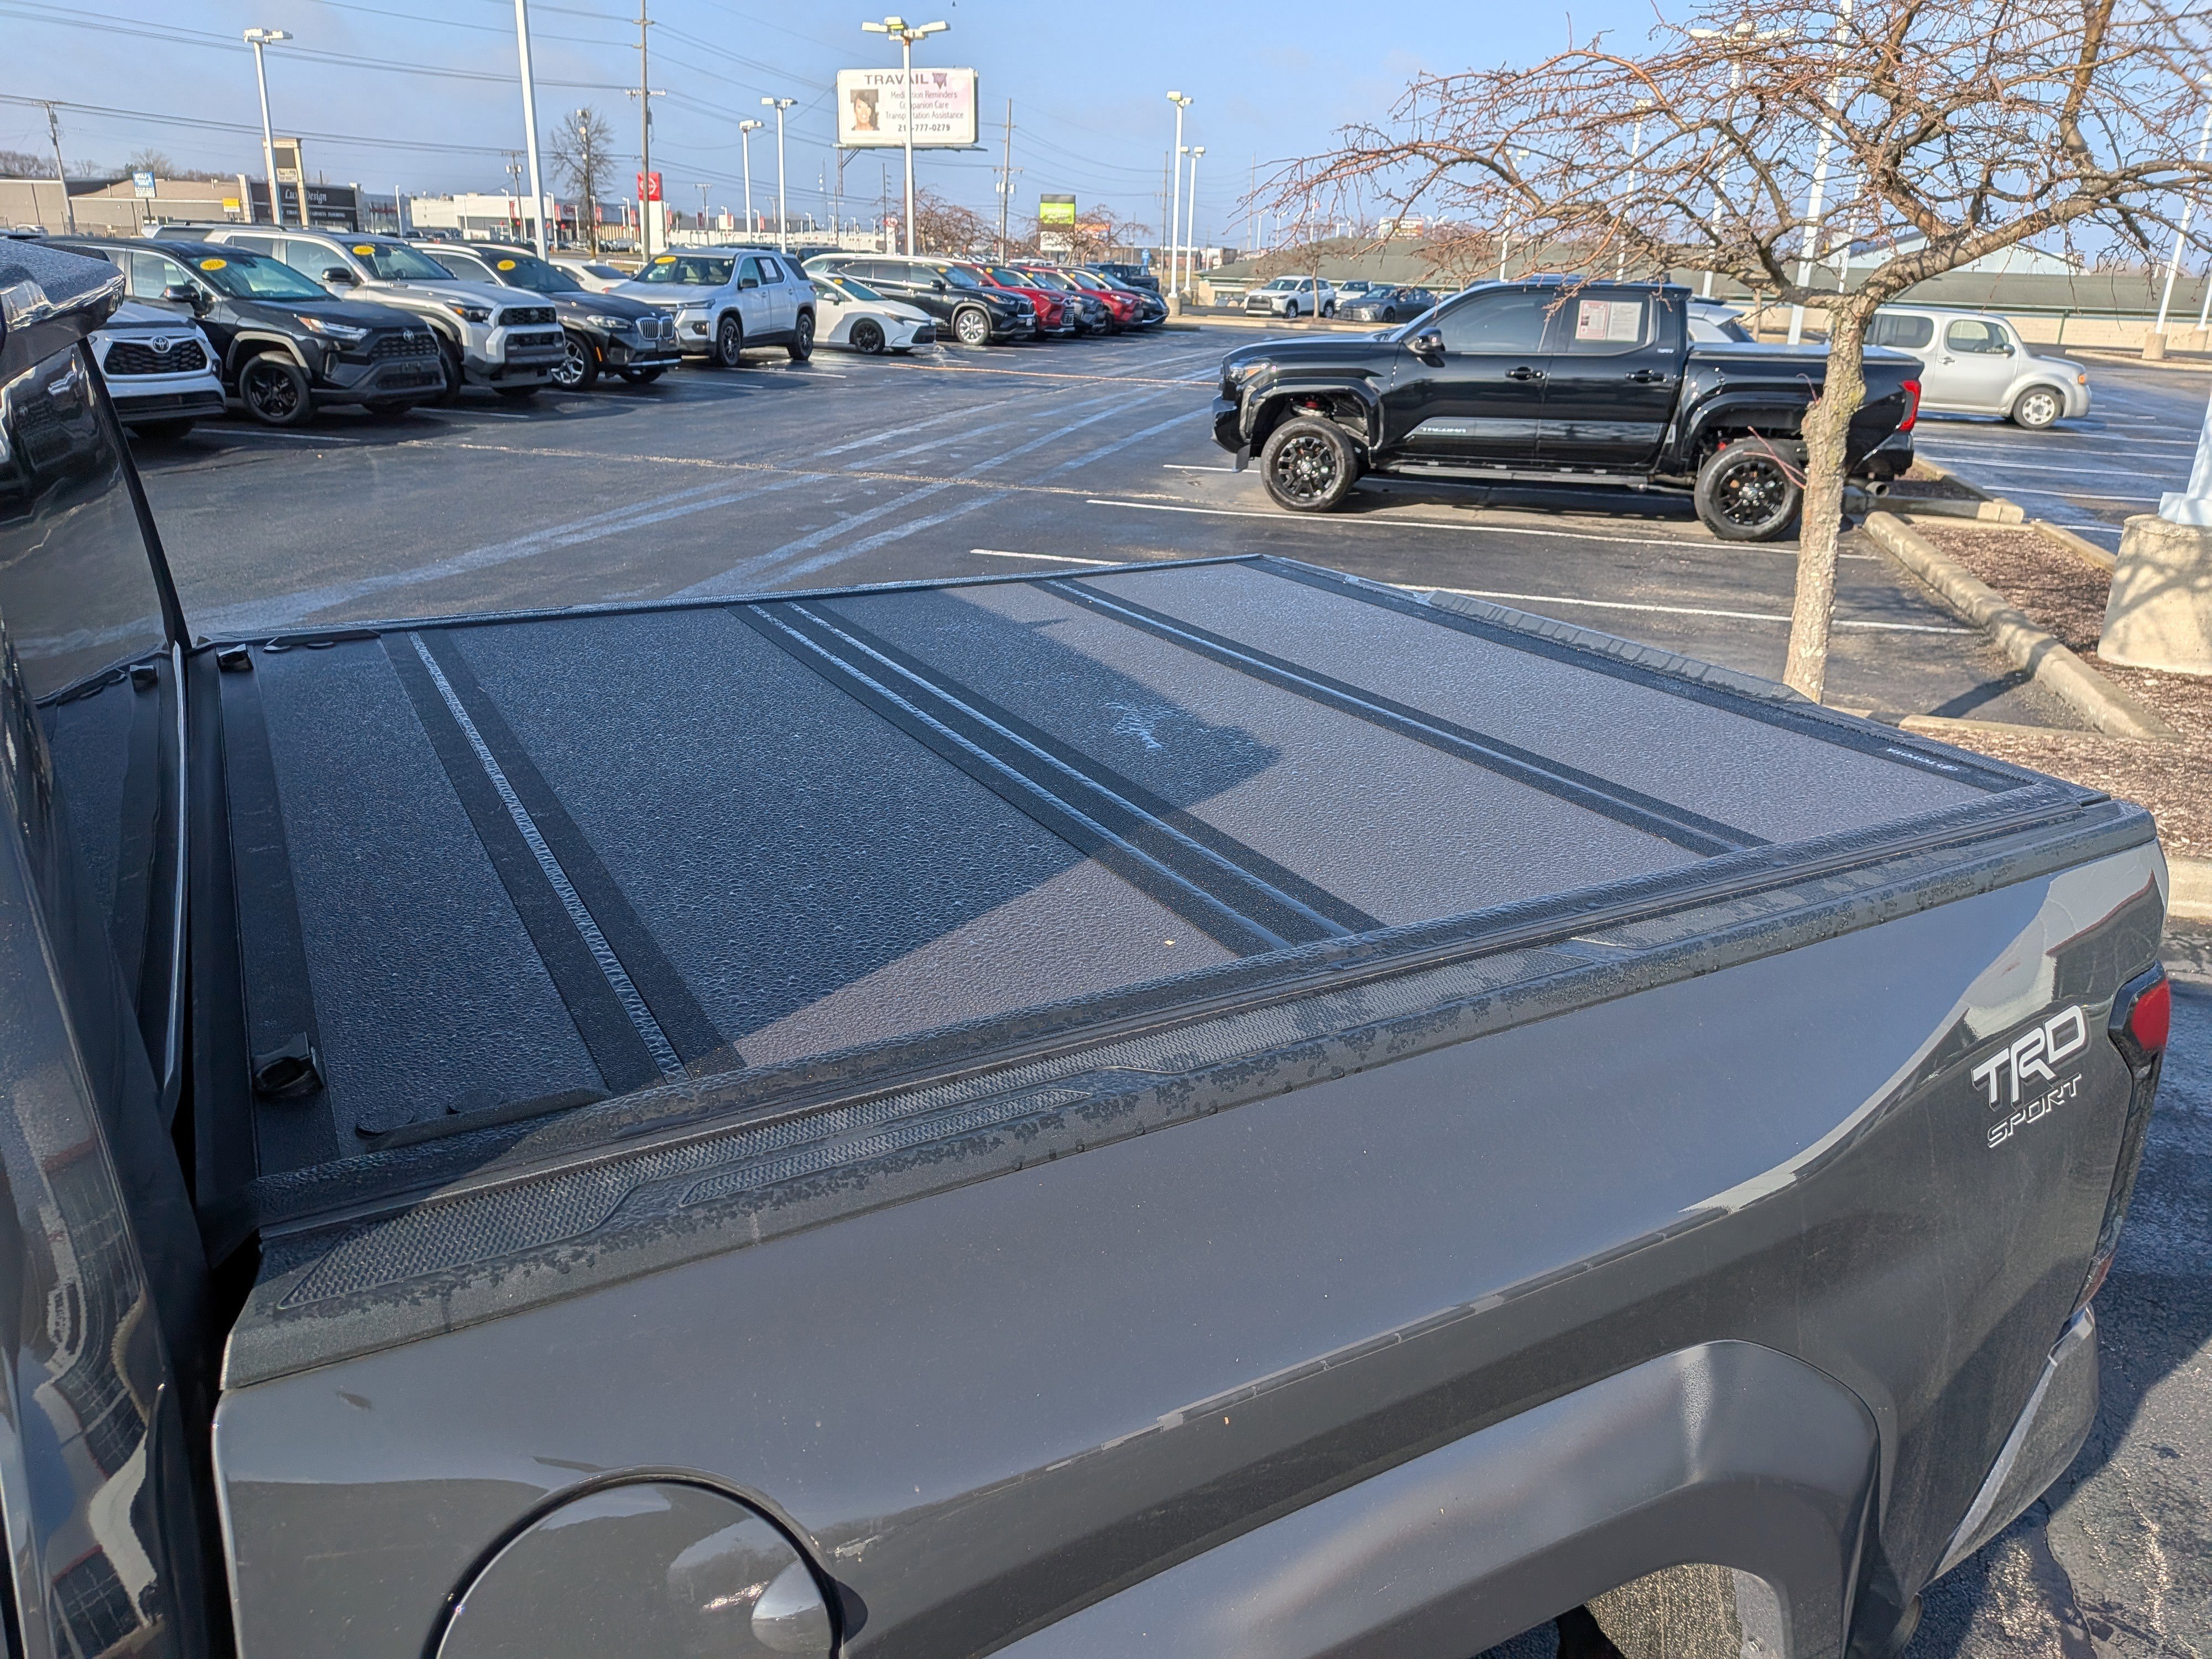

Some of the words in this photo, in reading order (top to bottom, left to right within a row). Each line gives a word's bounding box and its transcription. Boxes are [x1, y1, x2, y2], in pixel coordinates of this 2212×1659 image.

[864, 74, 929, 85] TRAVIL
[900, 101, 933, 110] Copanion
[886, 111, 930, 120] Transptation
[932, 111, 964, 119] Assistance
[1972, 1004, 2087, 1106] TRD
[1987, 1073, 2081, 1147] SPORT
